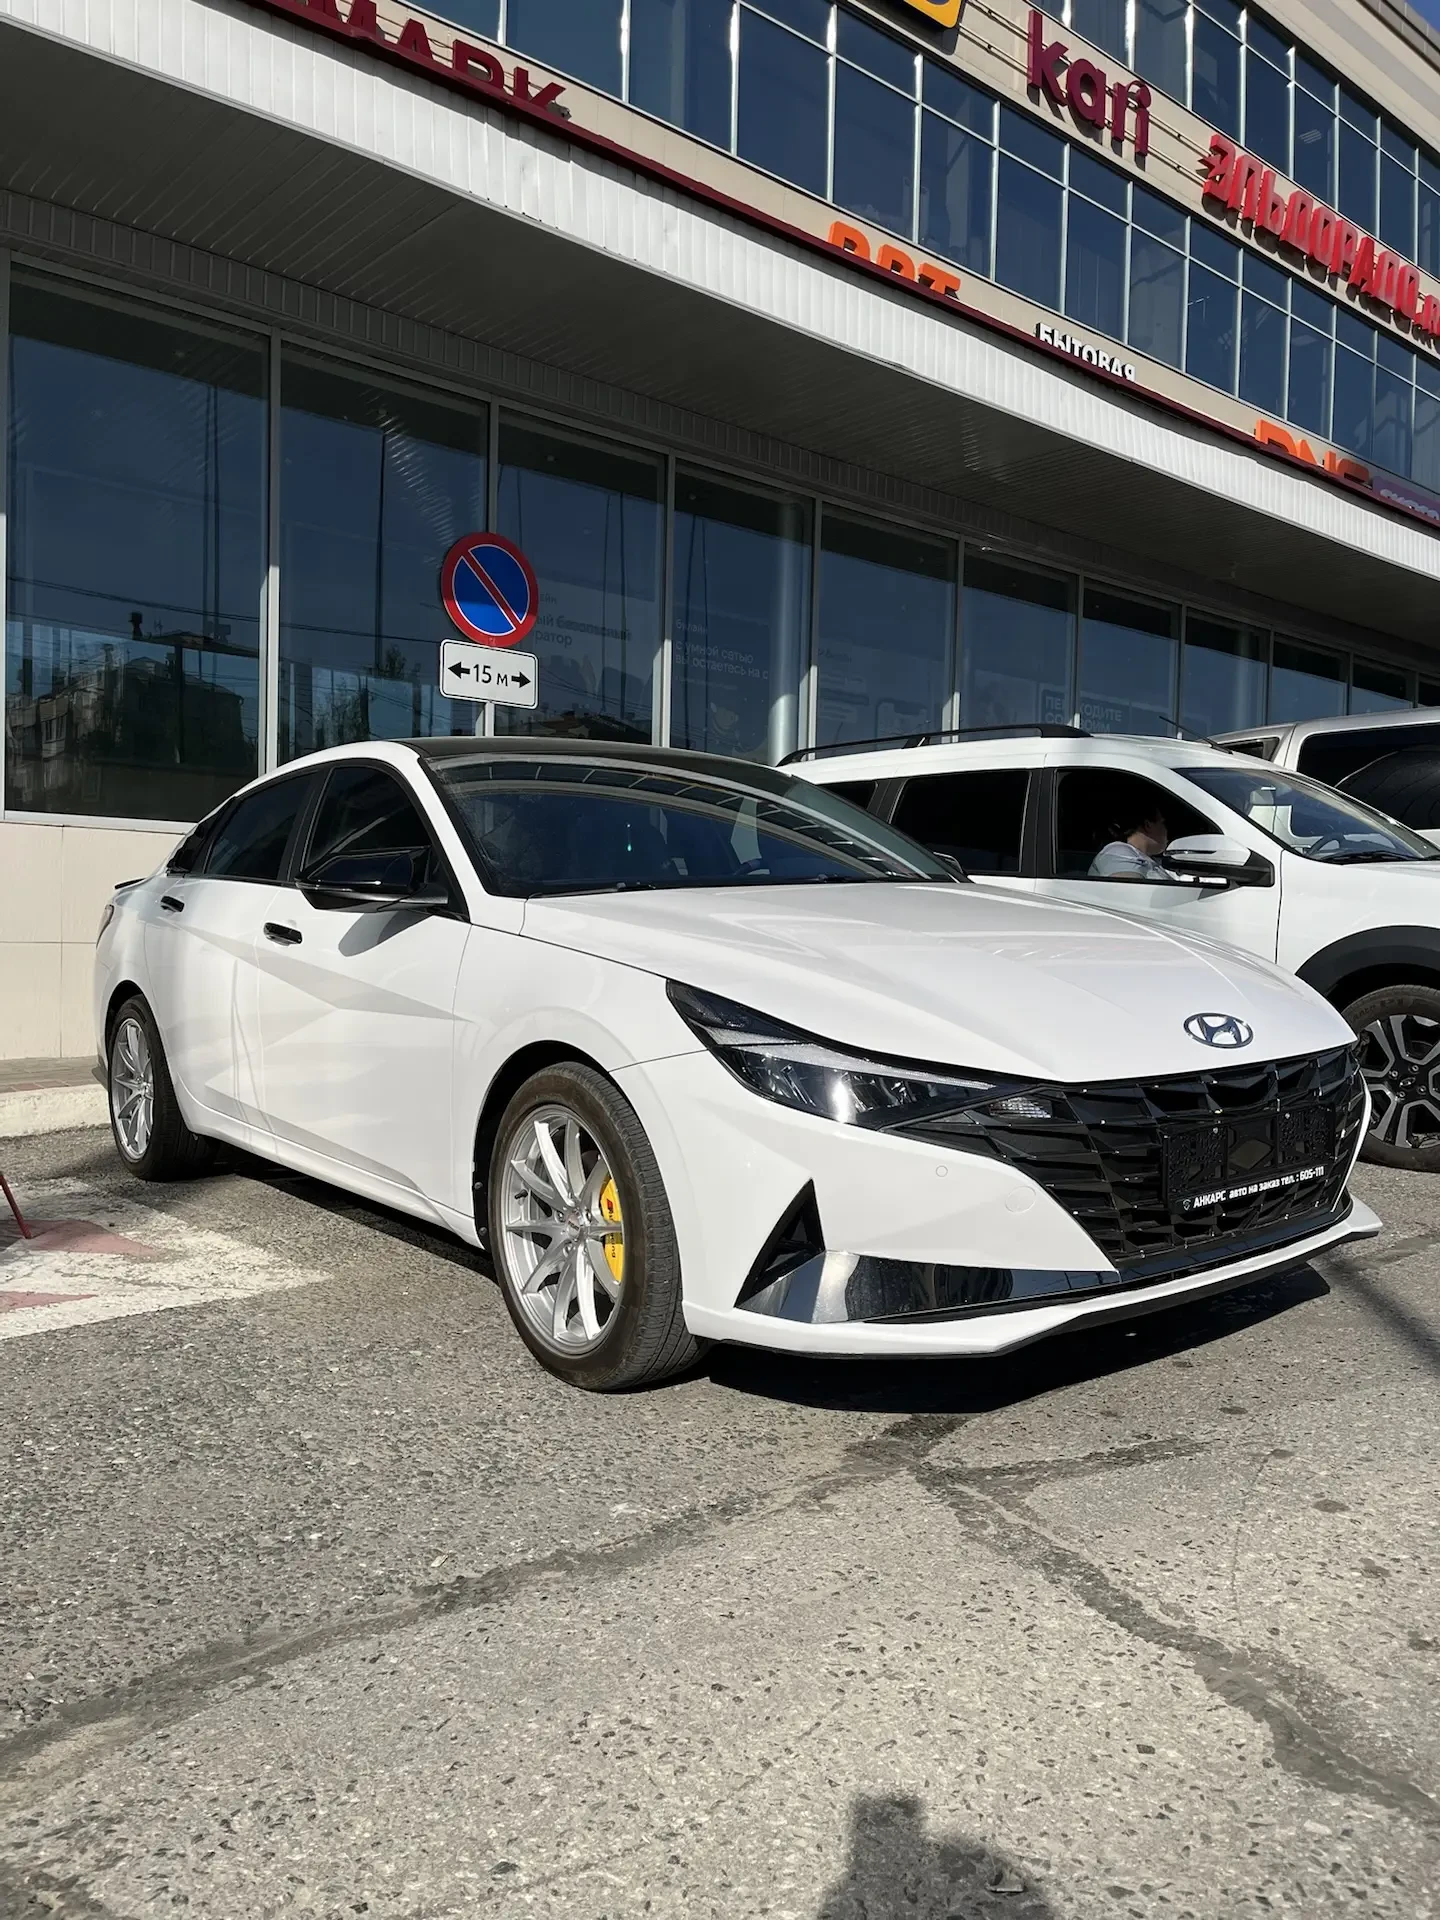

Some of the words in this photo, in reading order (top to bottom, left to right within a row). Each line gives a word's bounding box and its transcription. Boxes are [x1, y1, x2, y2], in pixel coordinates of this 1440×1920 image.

[1027, 9, 1152, 156] kari
[1197, 133, 1440, 336] ЭЛЬДОРАДО.R
[1037, 322, 1136, 381] БЫТОВАЯ
[473, 663, 492, 684] 15
[1045, 695, 1123, 723] ПЕОДИТЕ
[1193, 1190, 1226, 1209] АНКАРС
[1228, 1186, 1247, 1199] авто
[1248, 1183, 1258, 1194] на
[1259, 1178, 1280, 1192] заказ
[1299, 1166, 1325, 1181] 605-111
